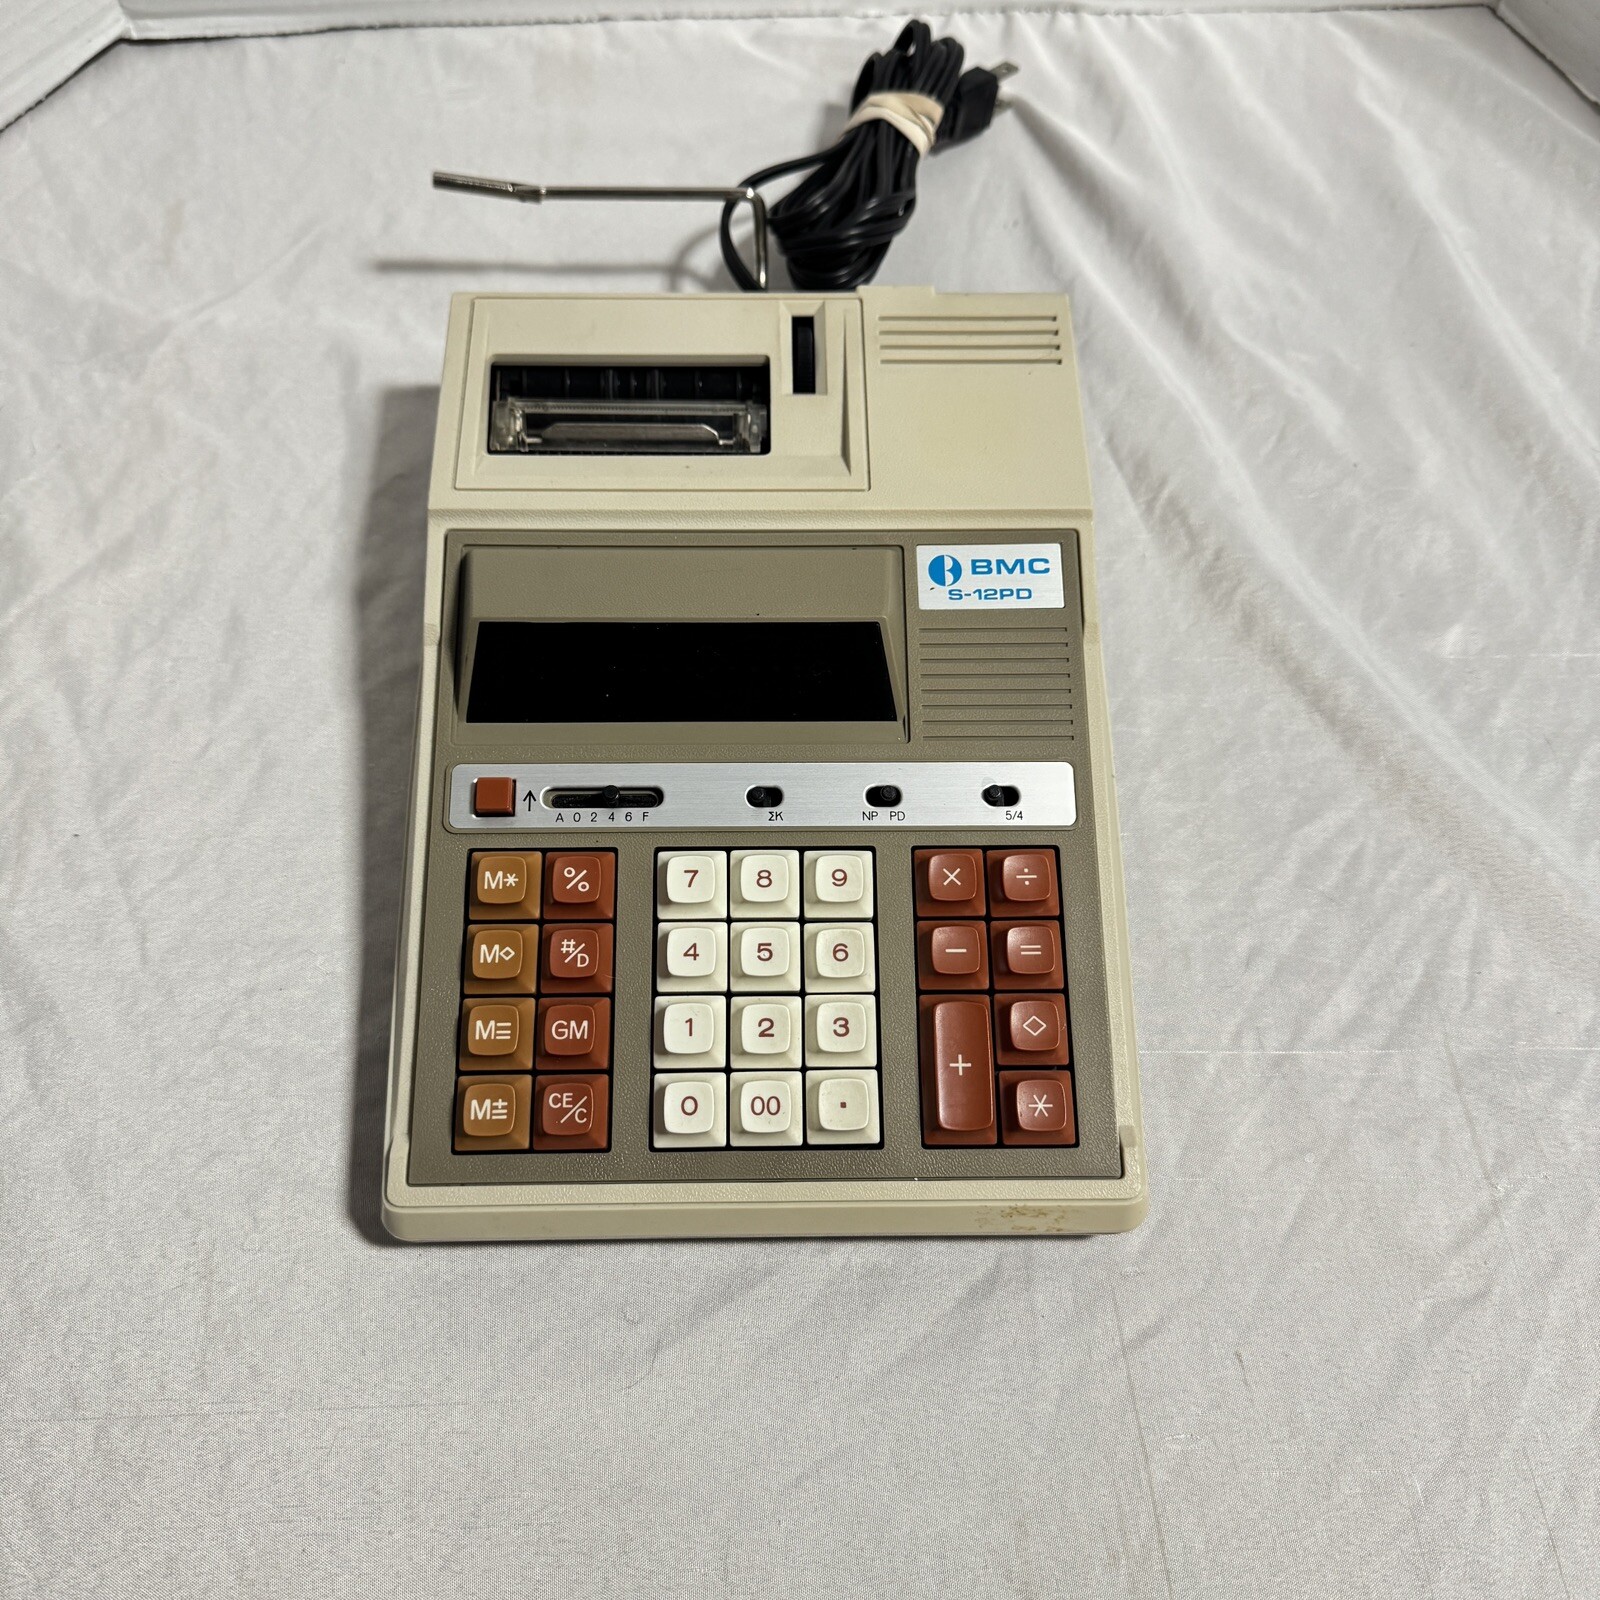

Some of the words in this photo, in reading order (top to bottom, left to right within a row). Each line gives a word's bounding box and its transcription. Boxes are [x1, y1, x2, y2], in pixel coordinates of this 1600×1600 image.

[971, 558, 1050, 574] BMC
[948, 589, 1032, 600] S-12PD
[555, 812, 564, 822] A
[573, 812, 581, 821] 0
[590, 812, 598, 821] 2
[608, 812, 616, 821] 4
[625, 812, 633, 821] 6
[642, 812, 649, 821] F
[863, 811, 878, 821] NP
[889, 811, 905, 821] PD
[1005, 810, 1024, 821] 5/4
[564, 866, 590, 892] %
[684, 870, 699, 888] 7
[756, 870, 772, 888] 8
[832, 869, 847, 886] 9
[683, 943, 699, 960] 4
[757, 943, 773, 962] 5
[832, 943, 848, 962] 6
[551, 1020, 588, 1040] GM
[685, 1018, 693, 1036] 1
[758, 1018, 774, 1037] 2
[833, 1018, 849, 1037] 3
[680, 1096, 698, 1116] 0
[751, 1096, 780, 1116] 00
